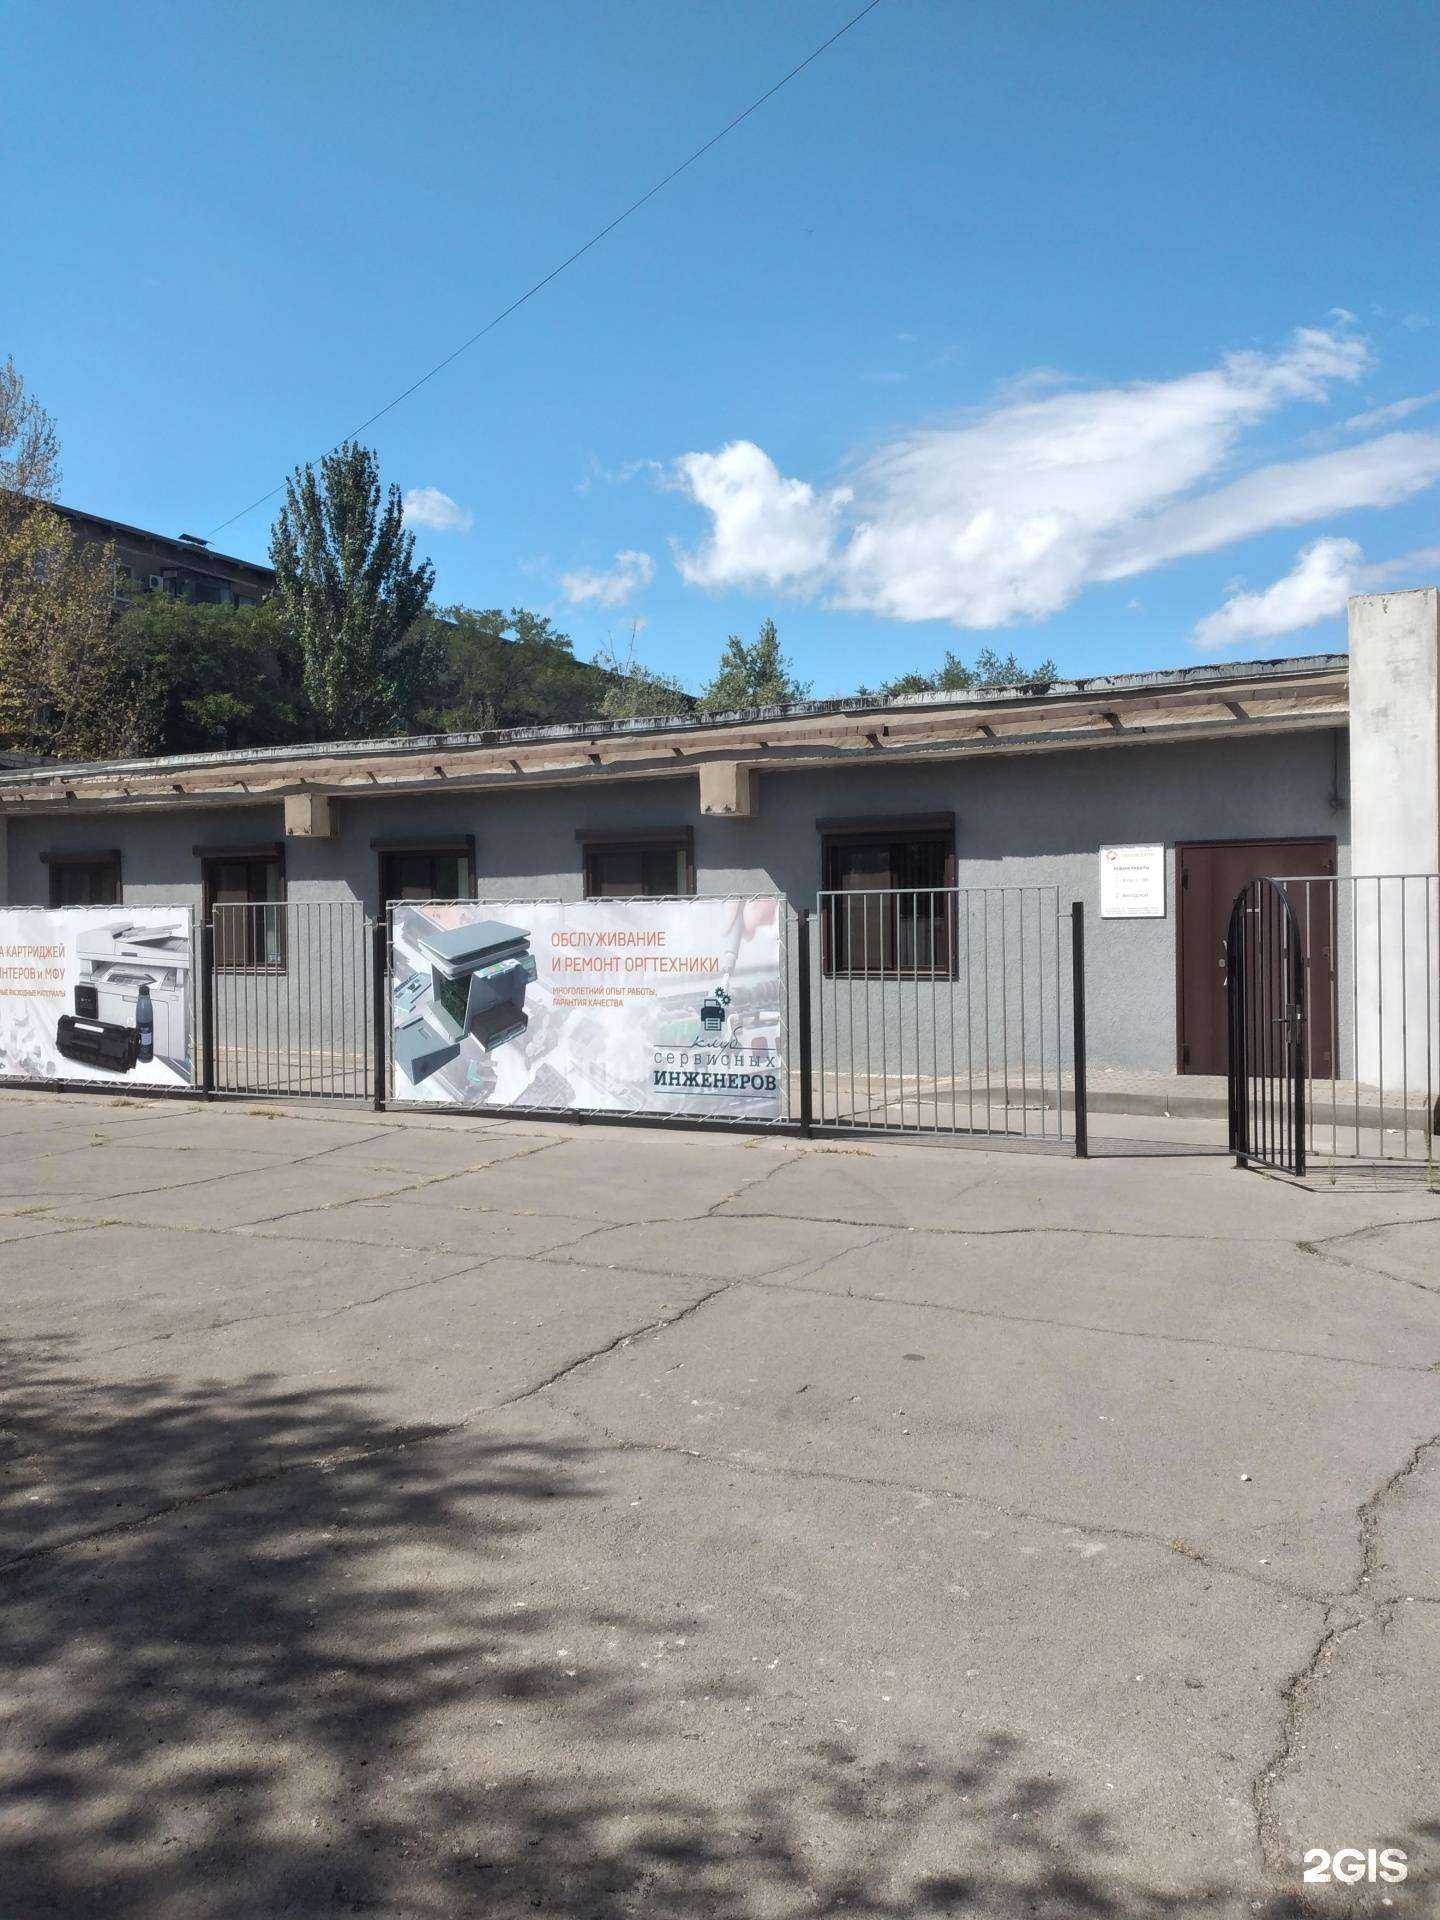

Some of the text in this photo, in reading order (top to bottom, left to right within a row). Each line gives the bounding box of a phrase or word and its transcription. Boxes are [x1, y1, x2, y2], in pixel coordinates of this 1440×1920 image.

[551, 931, 666, 947] ОБСЛУЖИВАНИЕ
[6, 943, 66, 960] КАРТРИДЖЕЙ
[552, 957, 719, 973] И РЕМОНТ ОРГТЕХНИКИ
[0, 967, 36, 980] НТЕРОВ
[45, 968, 66, 980] МФУ
[552, 985, 604, 996] МНОГОЛЕТНИЙ
[605, 987, 626, 996] ОПЫТ
[552, 998, 624, 1007] ГАРАНТИЯ КАЧЕСТВА
[654, 1051, 776, 1068] сервисных
[654, 1070, 777, 1091] ИНЖЕНЕРОВ
